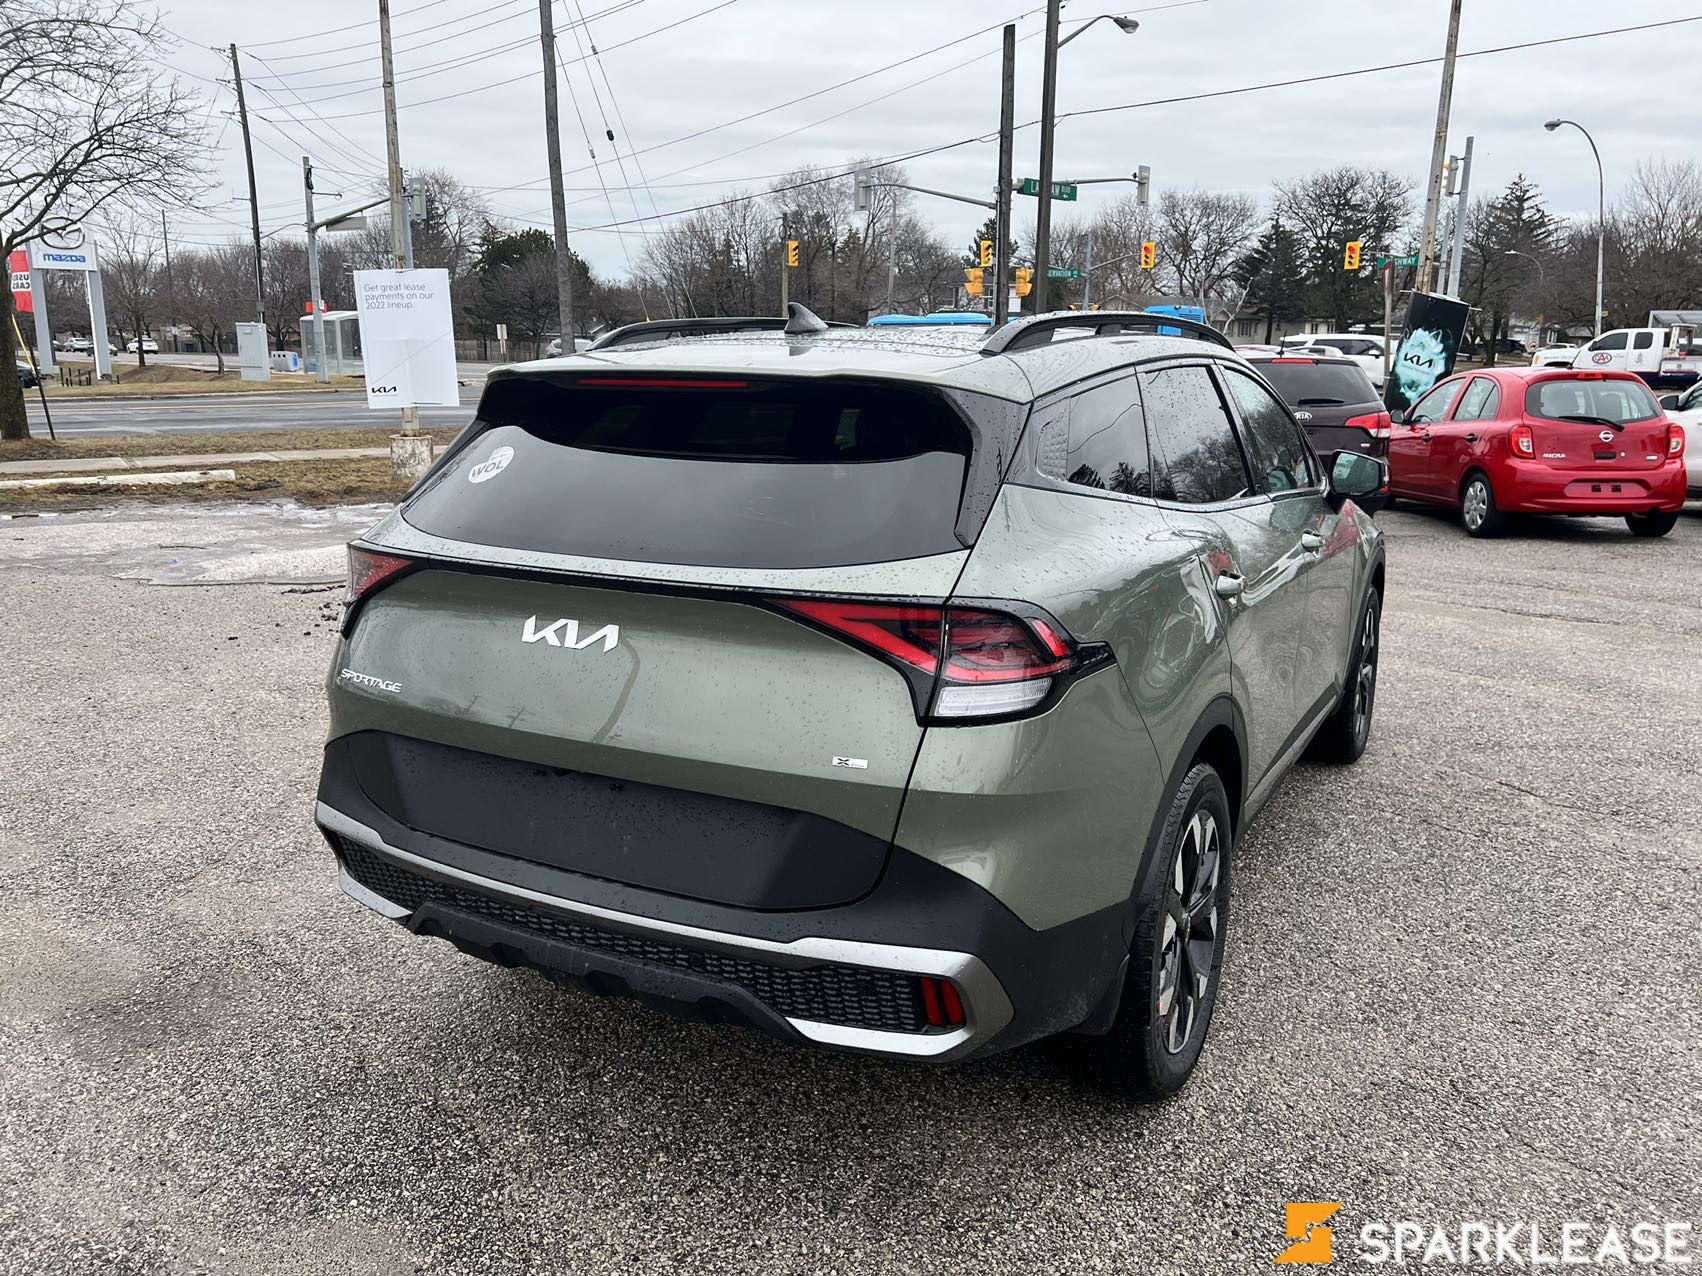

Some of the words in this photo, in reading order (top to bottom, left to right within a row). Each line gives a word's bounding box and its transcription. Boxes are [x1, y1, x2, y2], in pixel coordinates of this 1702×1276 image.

[43, 253, 87, 263] mazda
[363, 283, 378, 293] Get
[380, 283, 402, 294] great
[403, 282, 426, 292] lease
[364, 292, 404, 302] payments
[419, 292, 434, 300] our
[366, 301, 386, 310] 2022
[387, 299, 415, 310] lineup.
[1403, 352, 1434, 368] KIA
[522, 615, 620, 654] KIA
[341, 668, 402, 693] SPORTAGE
